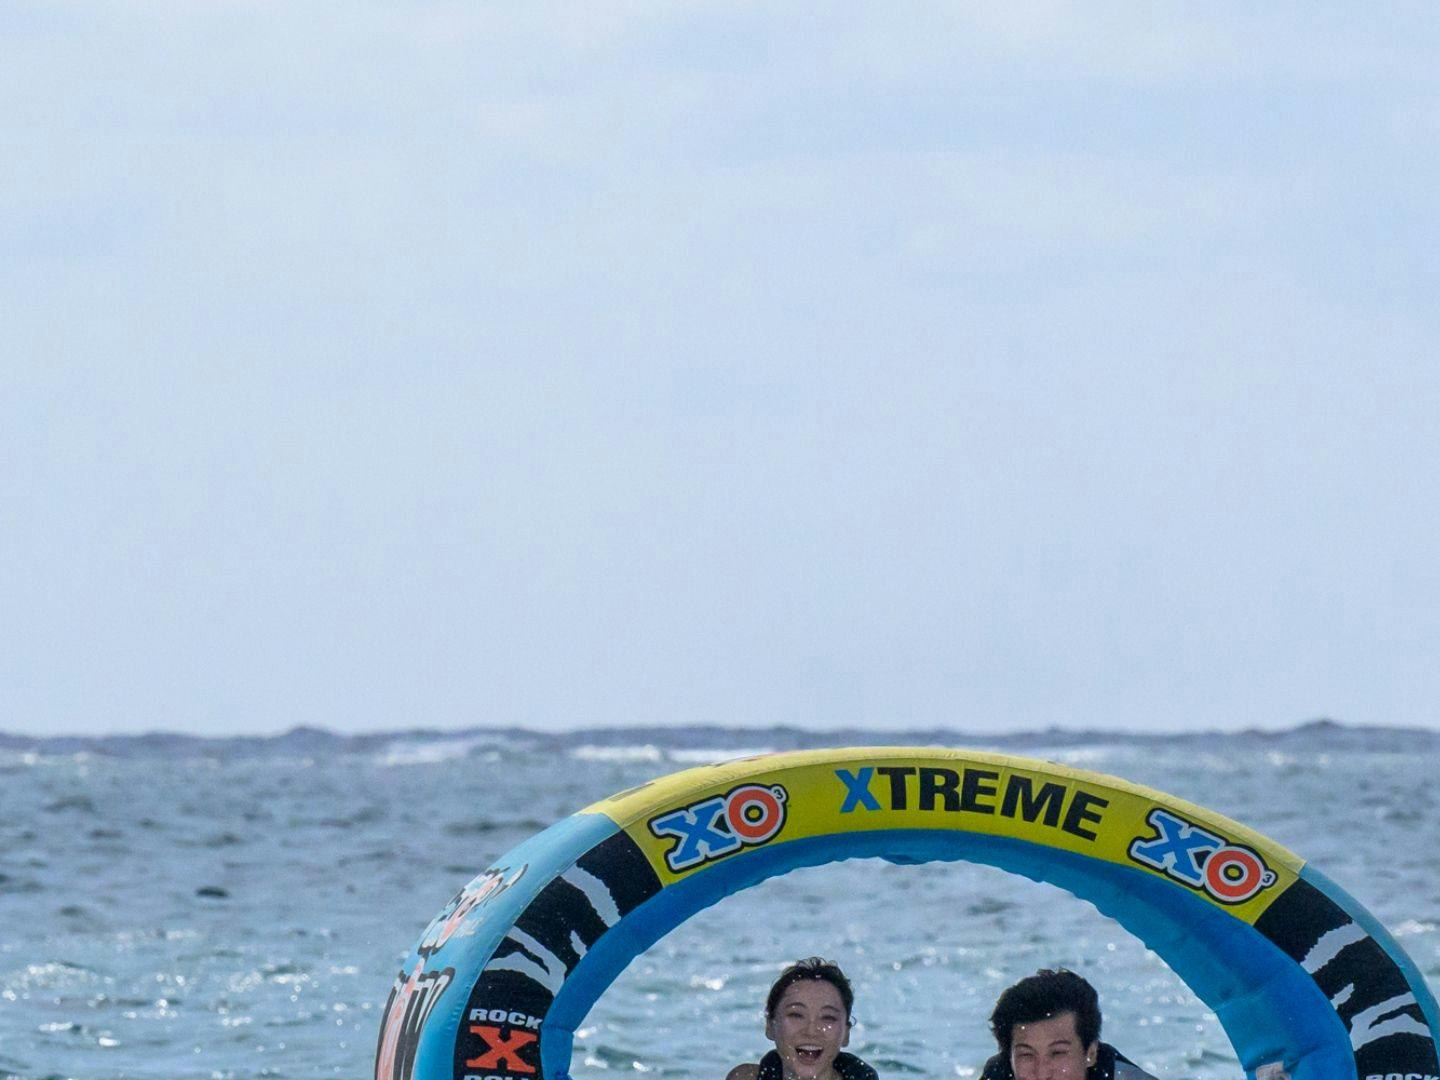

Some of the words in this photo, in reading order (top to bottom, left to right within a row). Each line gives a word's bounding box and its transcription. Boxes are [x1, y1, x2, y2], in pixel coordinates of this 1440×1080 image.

[834, 766, 1110, 842] XTREME
[469, 1008, 543, 1029] ROCK
[466, 1025, 537, 1073] X
